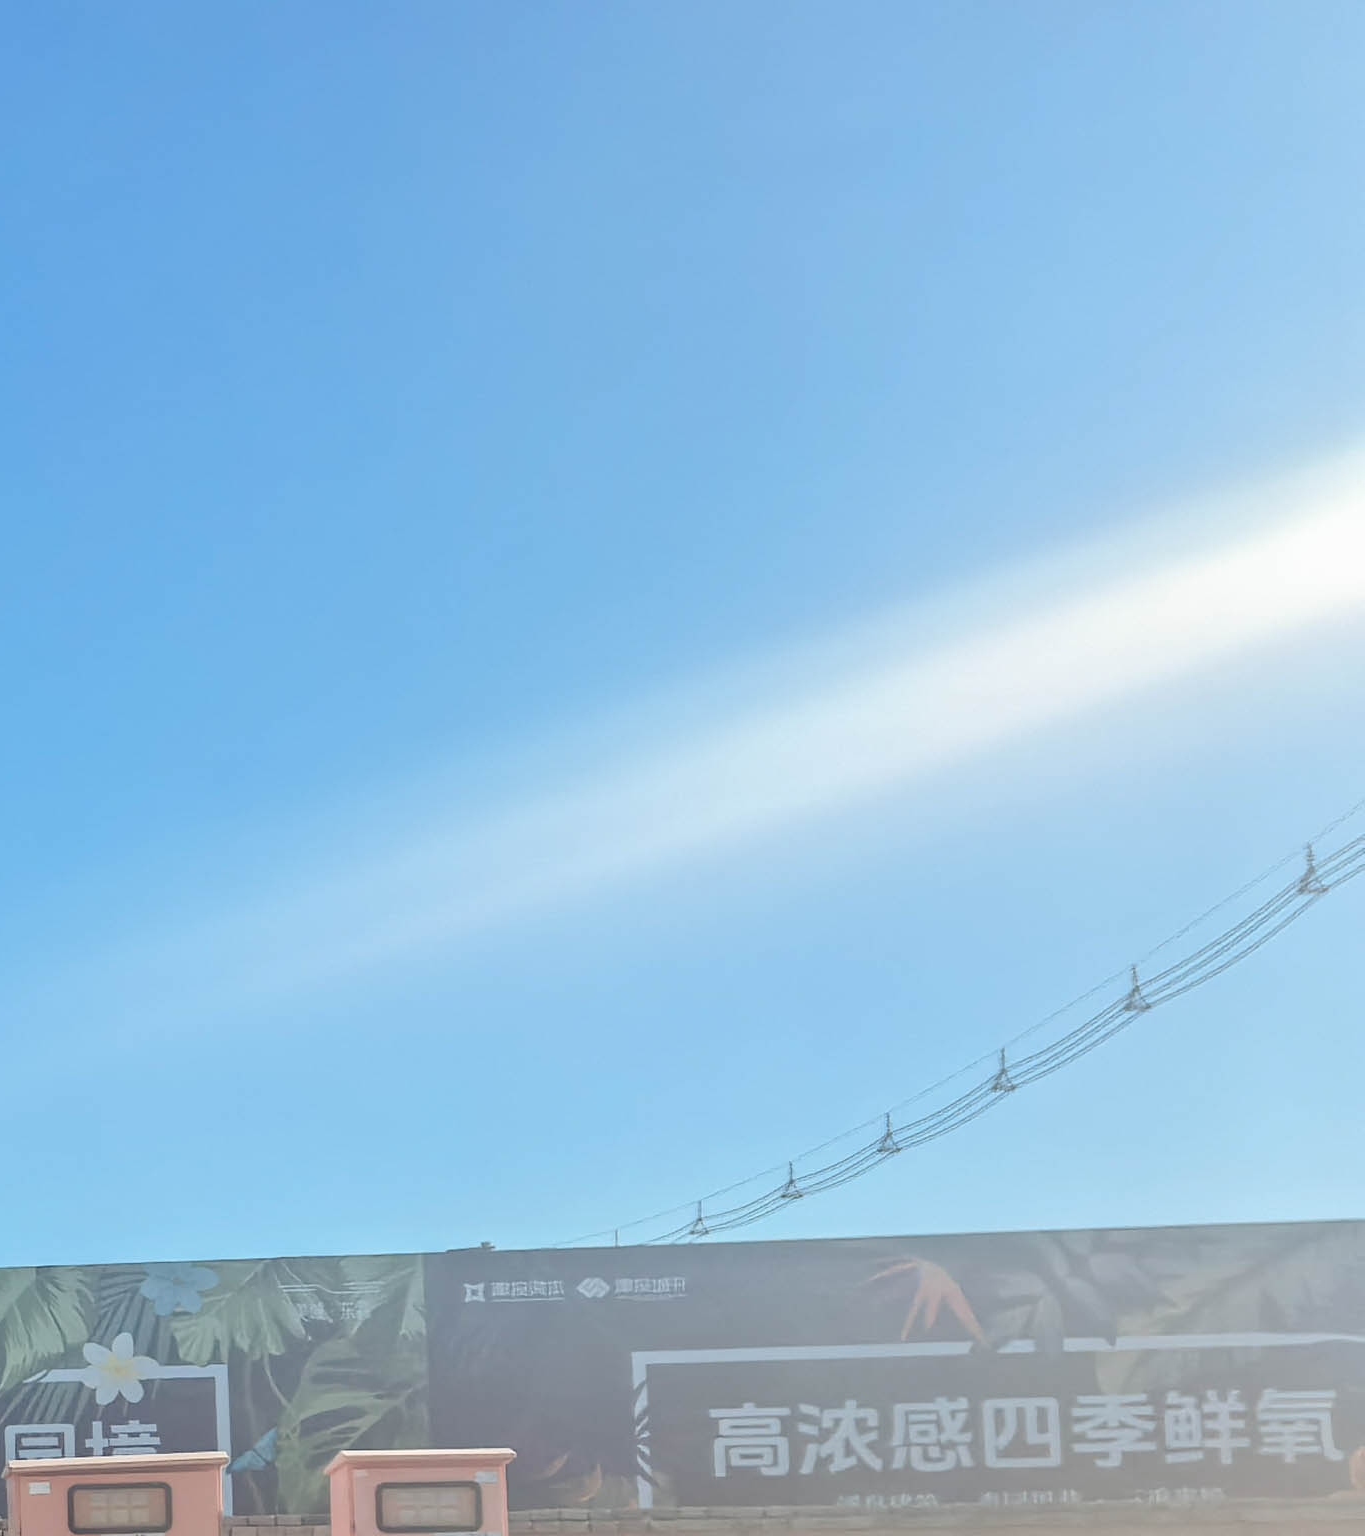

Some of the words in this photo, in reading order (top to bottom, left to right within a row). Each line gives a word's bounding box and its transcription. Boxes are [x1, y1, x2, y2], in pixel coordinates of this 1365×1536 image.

[707, 1388, 1345, 1478] 高浓感四季鲜氧
